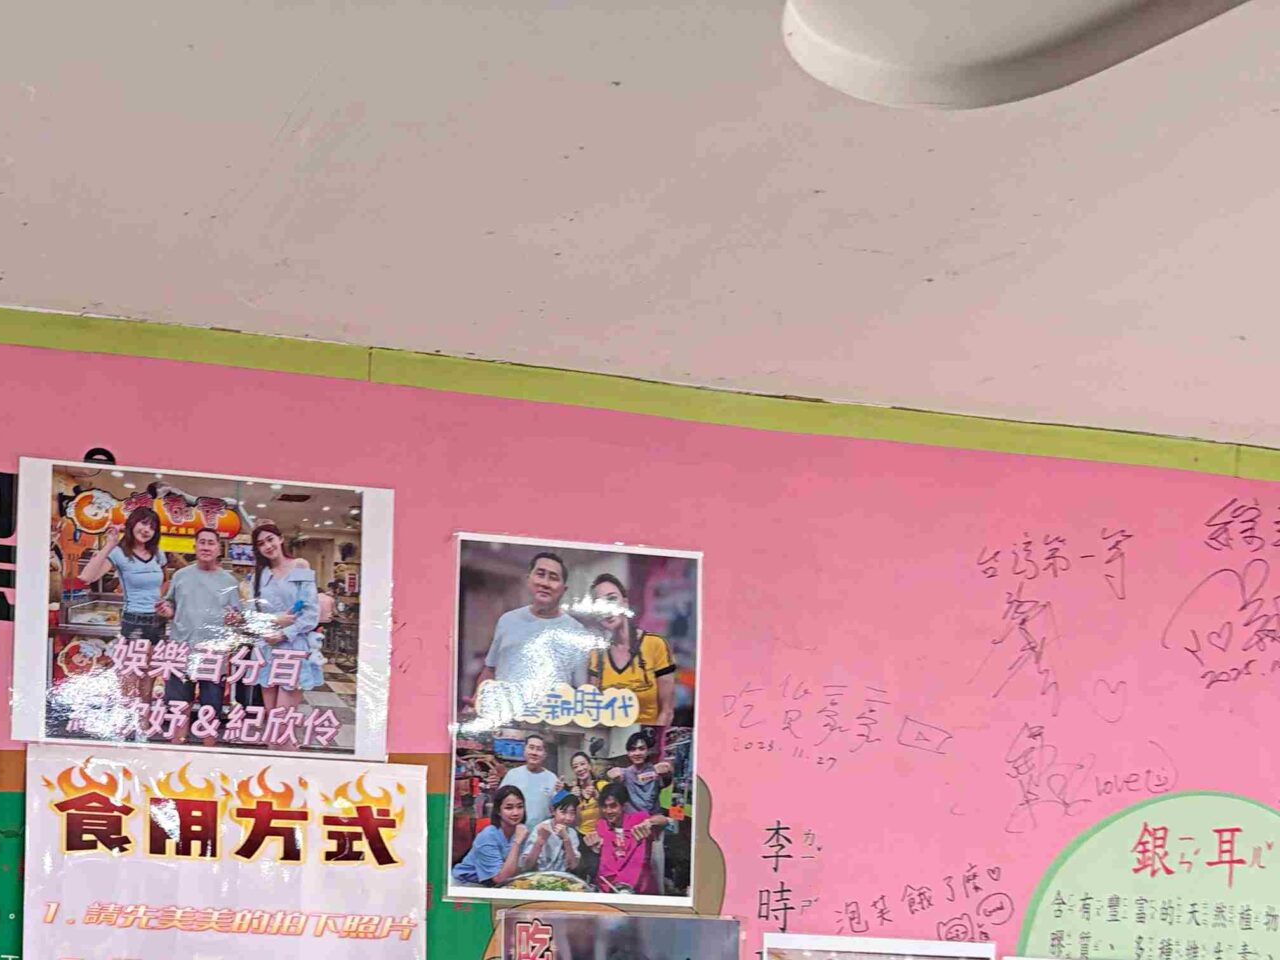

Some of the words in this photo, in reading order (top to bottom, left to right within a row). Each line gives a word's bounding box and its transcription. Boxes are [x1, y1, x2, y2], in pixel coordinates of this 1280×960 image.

[111, 639, 309, 688] 娛樂百分百
[54, 790, 402, 867] 食用方式
[756, 820, 796, 936] 李時
